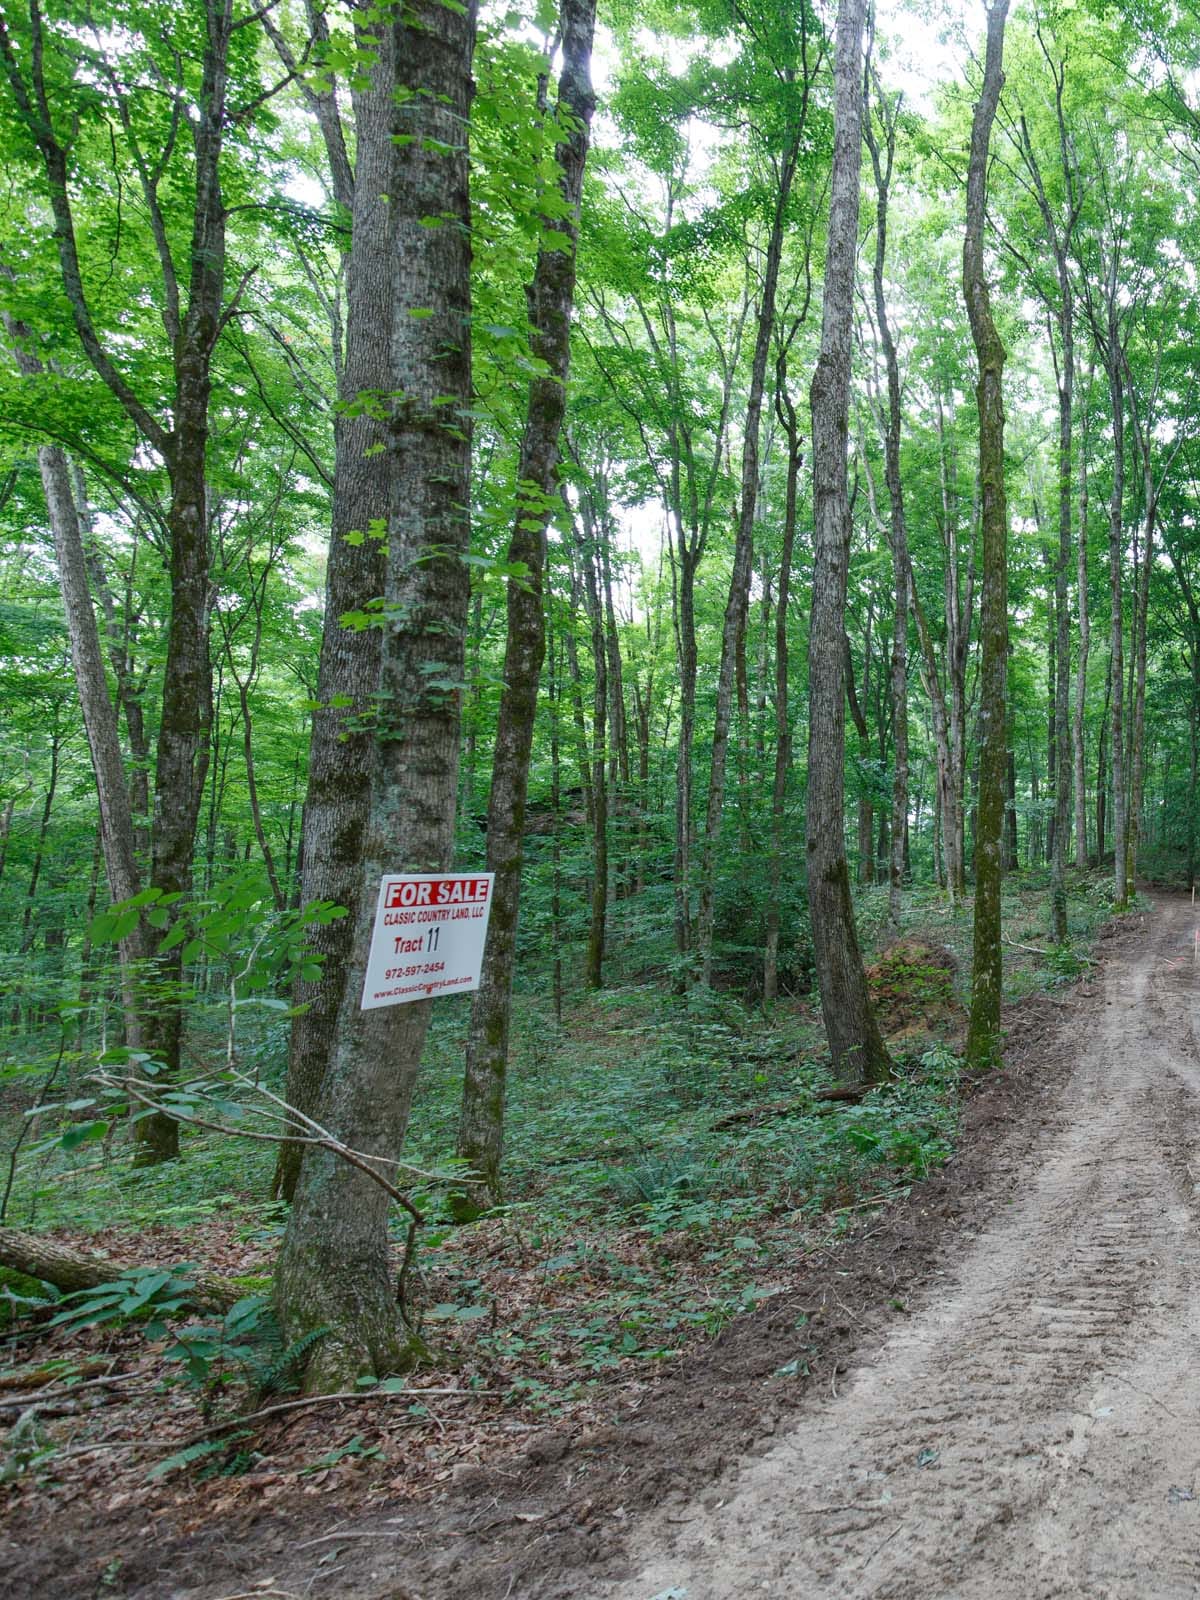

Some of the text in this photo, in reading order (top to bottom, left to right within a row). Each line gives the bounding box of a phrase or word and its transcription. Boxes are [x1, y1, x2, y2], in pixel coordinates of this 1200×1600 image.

[386, 880, 487, 906] FOR SALE
[384, 906, 484, 926] CLASSIC COUNTRY LAND, LLC
[394, 927, 440, 954] Tract 11
[385, 962, 445, 979] 972-597-2454
